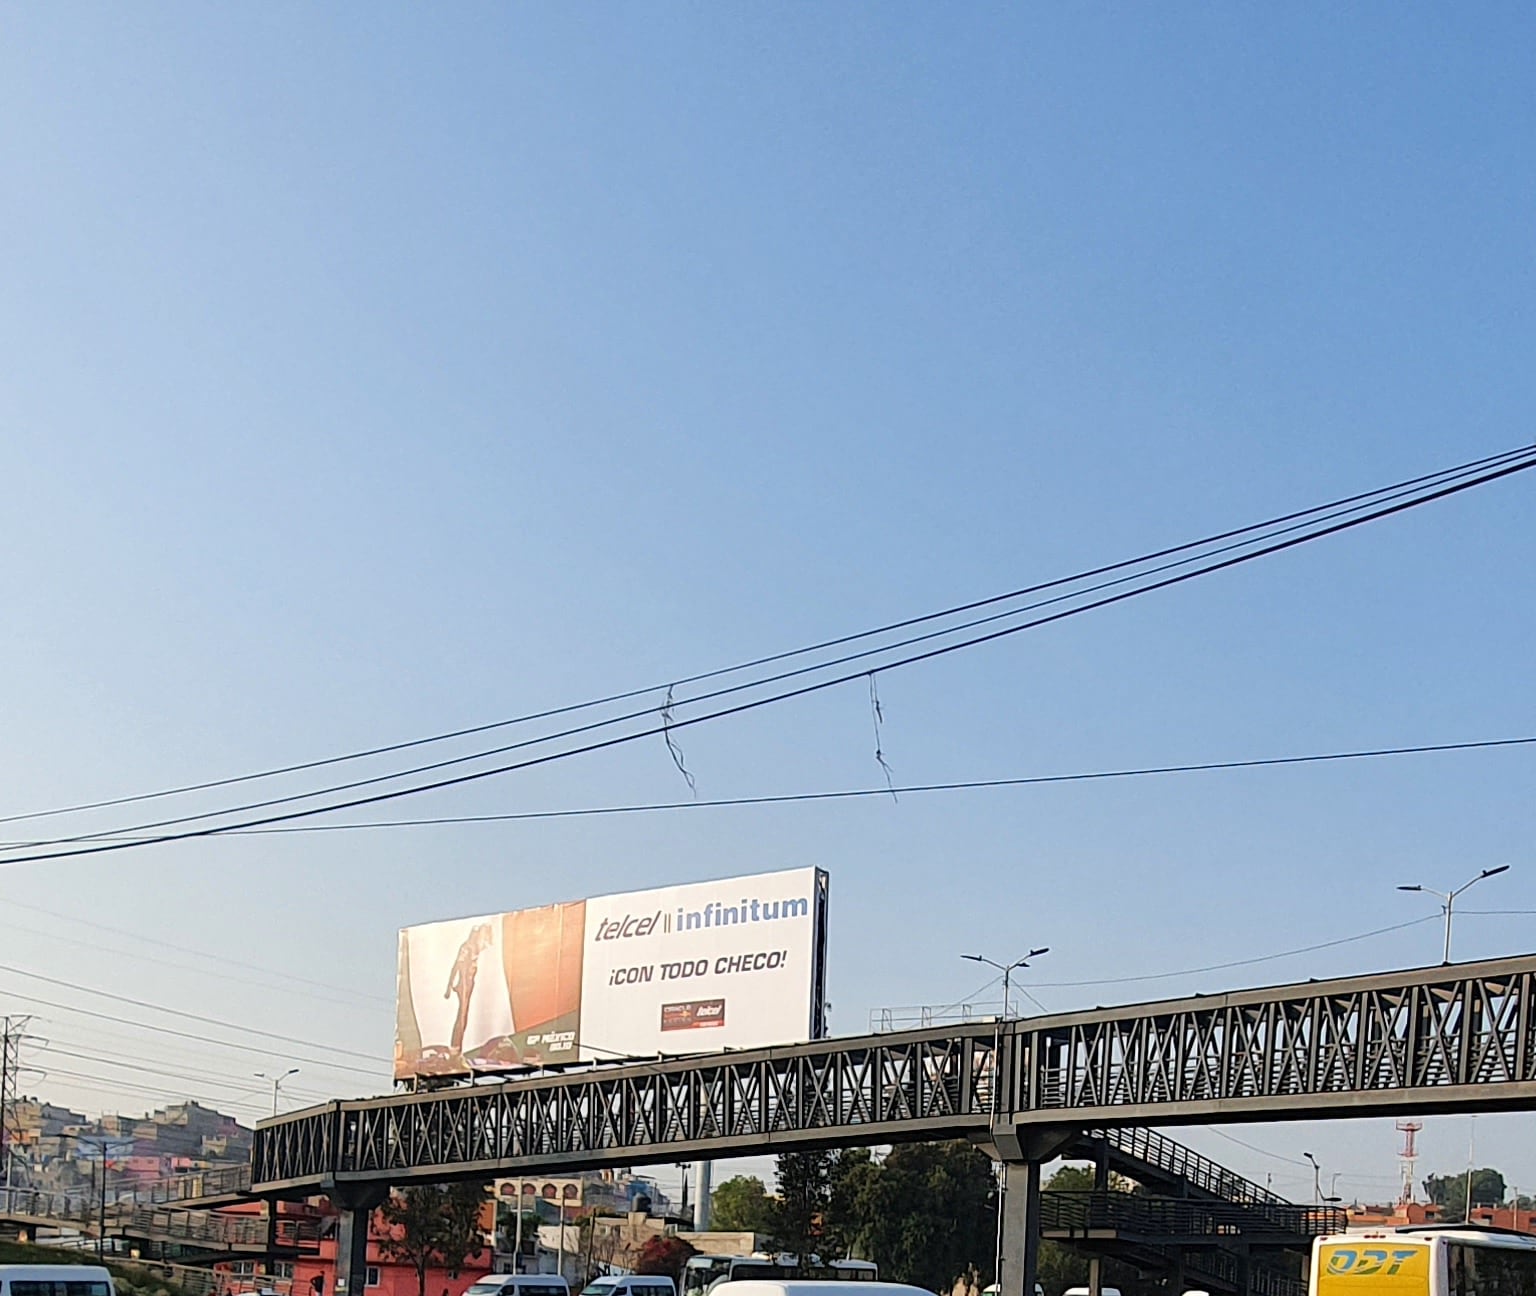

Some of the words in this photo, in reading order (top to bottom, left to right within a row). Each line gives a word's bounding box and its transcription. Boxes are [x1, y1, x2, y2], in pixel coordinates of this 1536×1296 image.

[594, 910, 662, 942] telcel
[676, 895, 808, 931] infinitum
[608, 963, 654, 986] ¡CON
[659, 958, 708, 981] TODO
[714, 950, 787, 976] CHECO!
